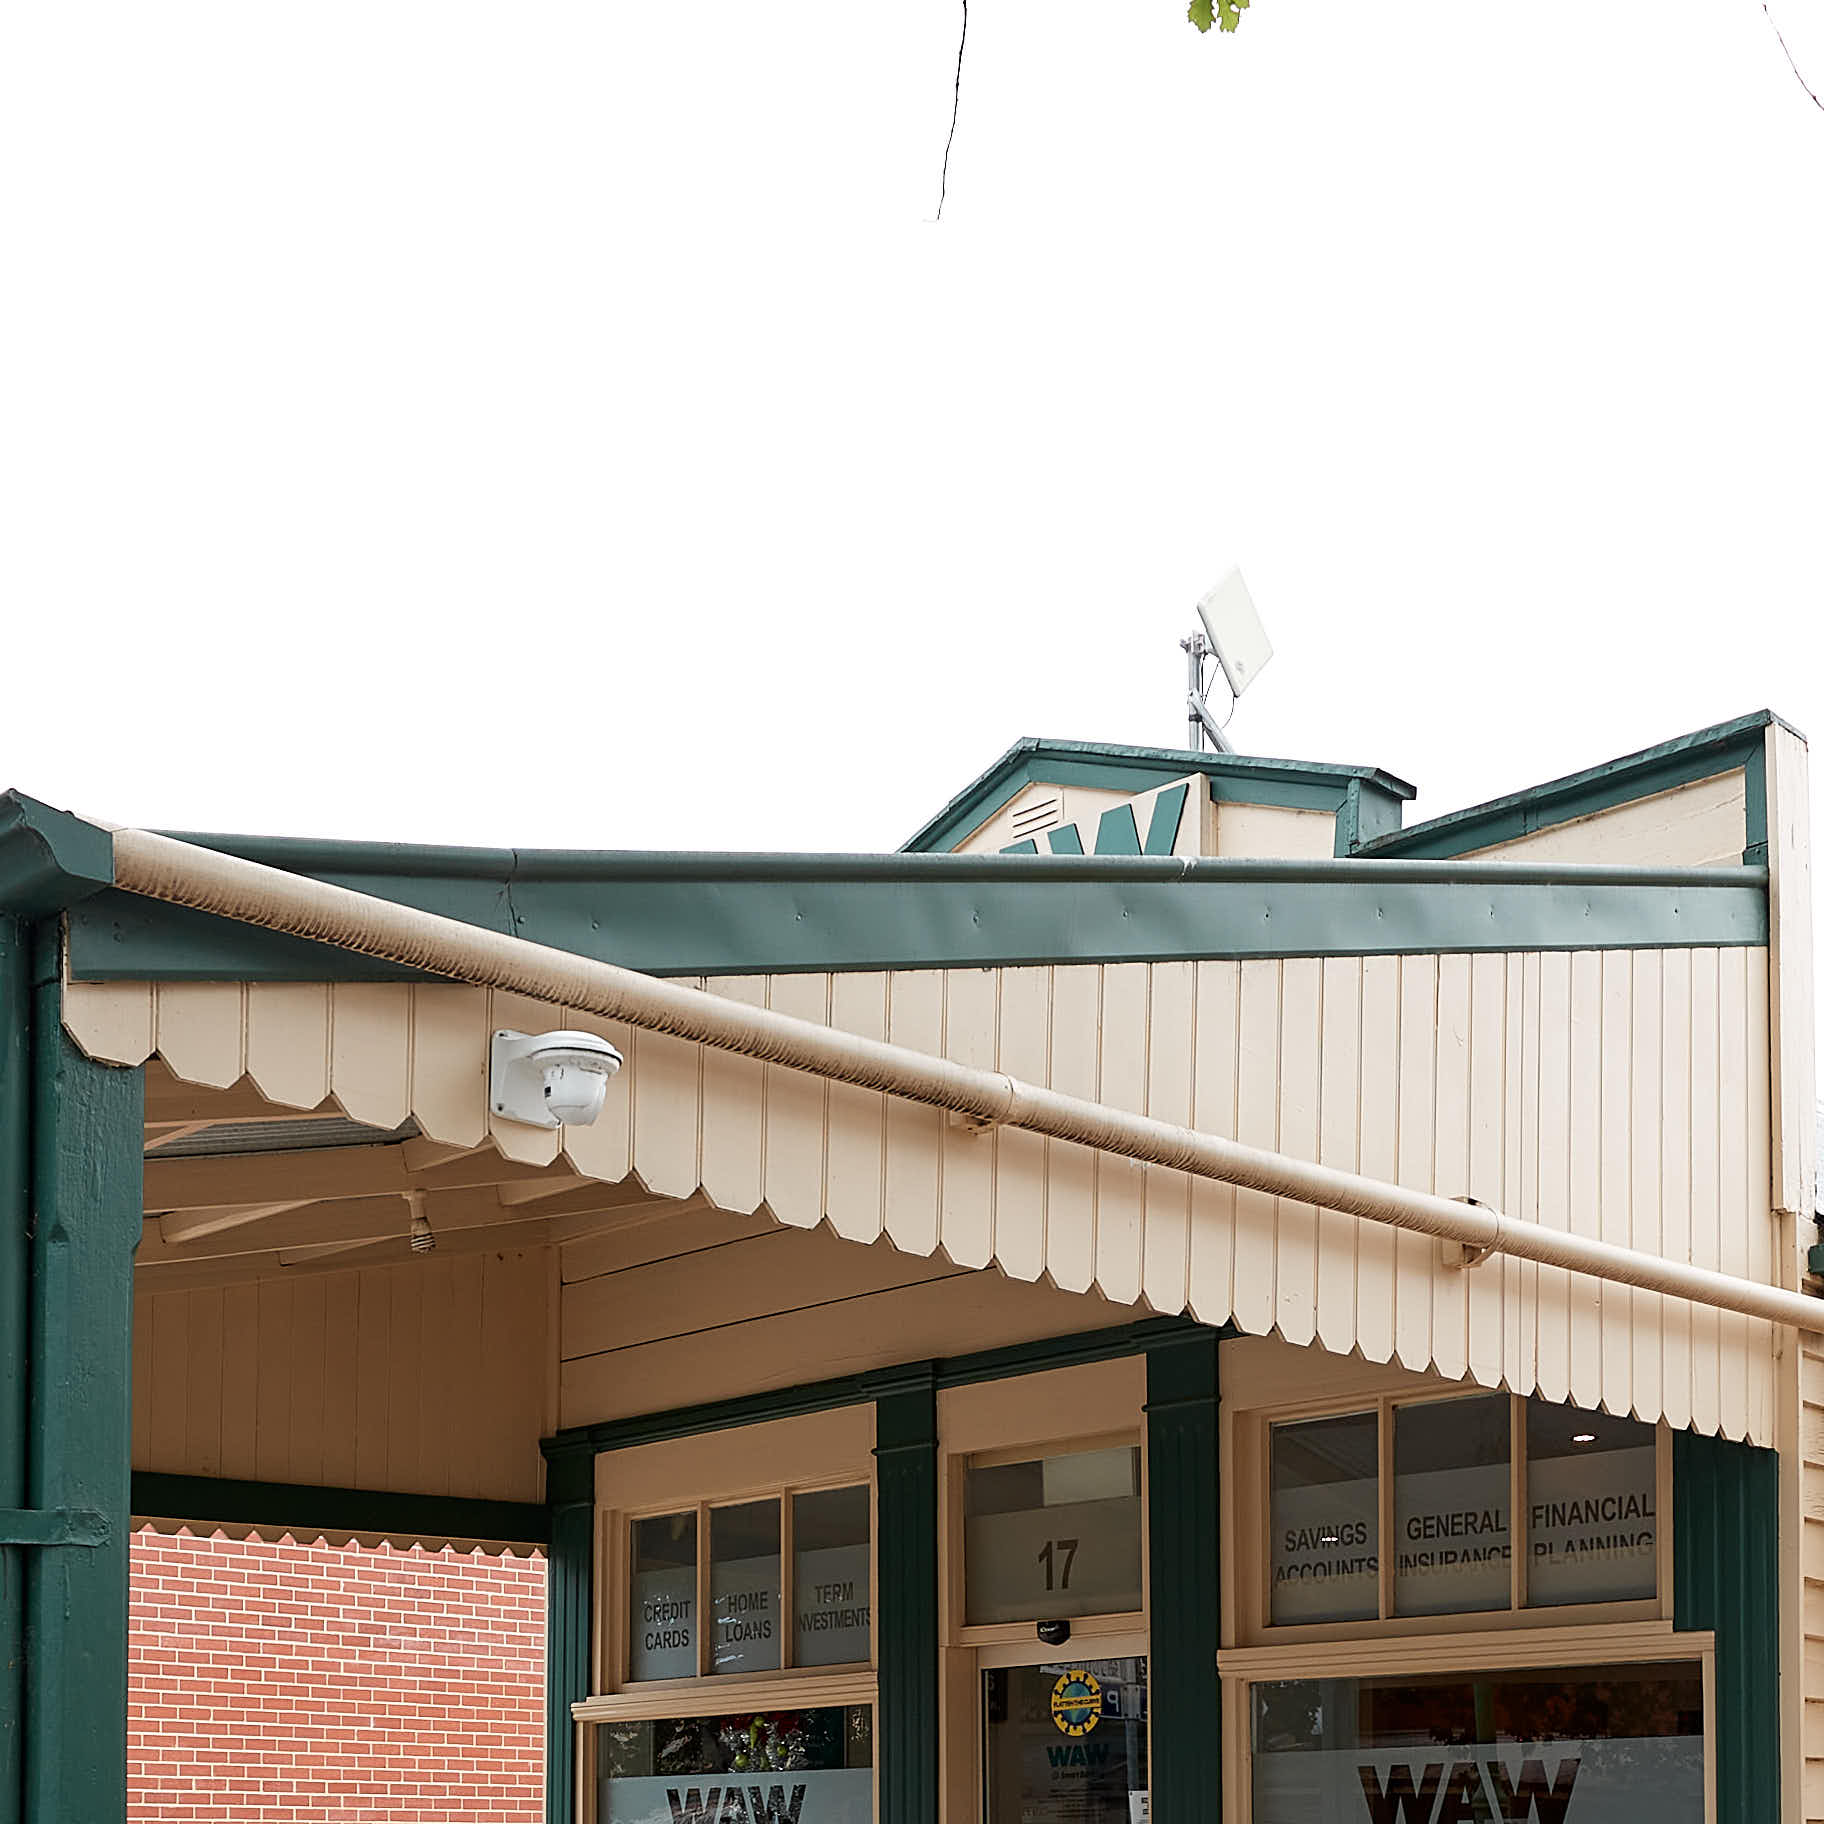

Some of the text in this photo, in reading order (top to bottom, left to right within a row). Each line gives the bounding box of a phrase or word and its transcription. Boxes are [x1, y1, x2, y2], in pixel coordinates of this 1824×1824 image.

[1406, 1510, 1506, 1541] GENERAL
[1532, 1493, 1655, 1529] FINANCIAL
[1285, 1522, 1367, 1552] SAVINGS
[1534, 1532, 1654, 1567] PLANNING
[1038, 1539, 1079, 1591] 17
[1275, 1556, 1379, 1586] ACCOUNTS
[1399, 1544, 1511, 1577] INSURANCE
[728, 1591, 768, 1613] HOME
[815, 1582, 853, 1604] TERM
[644, 1600, 691, 1623] CREDIT
[799, 1607, 871, 1632] NVESTMENTS
[645, 1629, 689, 1650] CARDS
[726, 1620, 772, 1643] LOANS
